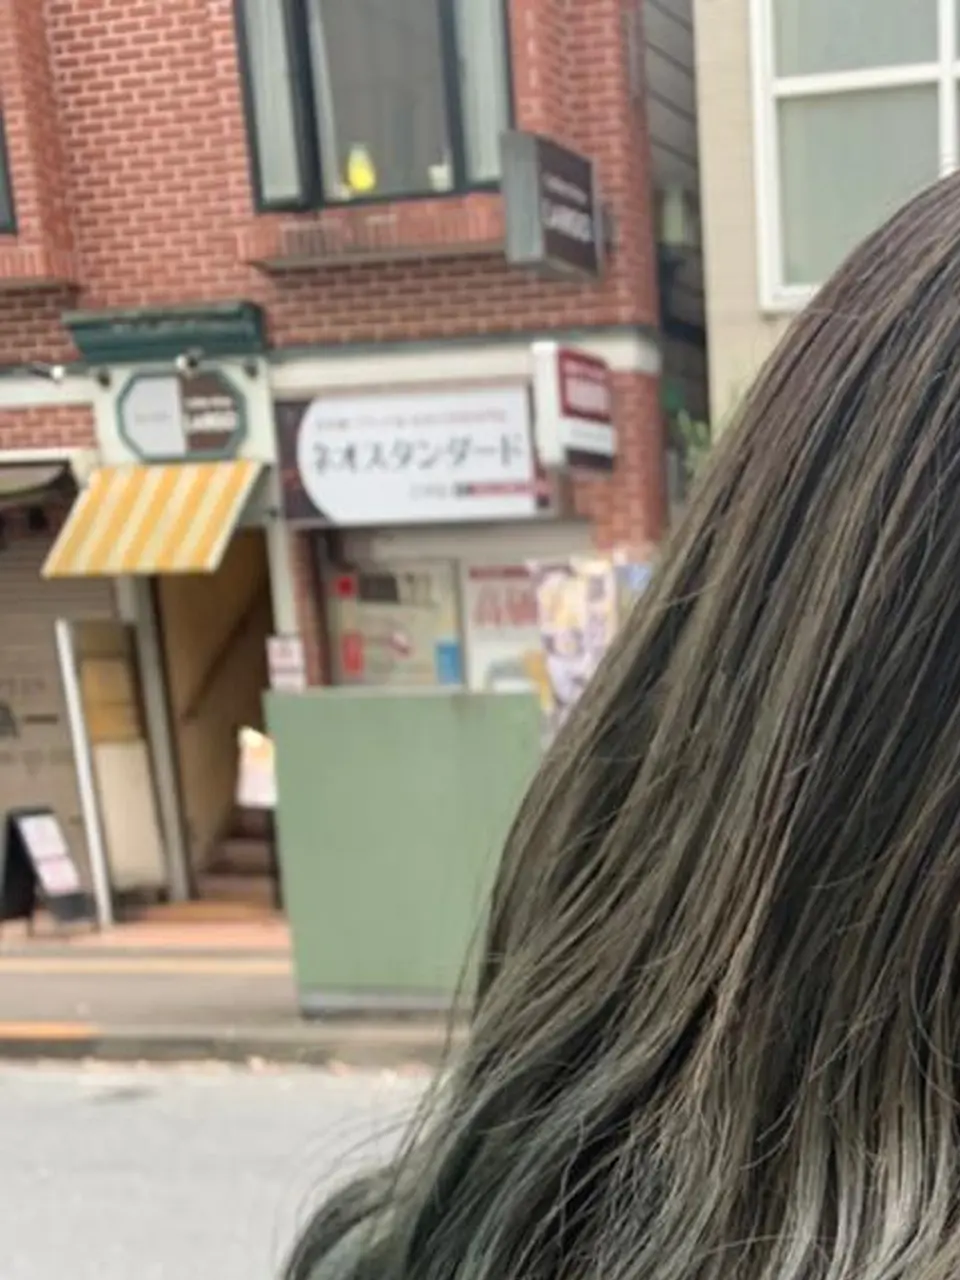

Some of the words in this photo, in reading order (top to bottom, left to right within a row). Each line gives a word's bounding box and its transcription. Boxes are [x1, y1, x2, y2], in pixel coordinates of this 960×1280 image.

[312, 432, 524, 475] ネオスタンダード
